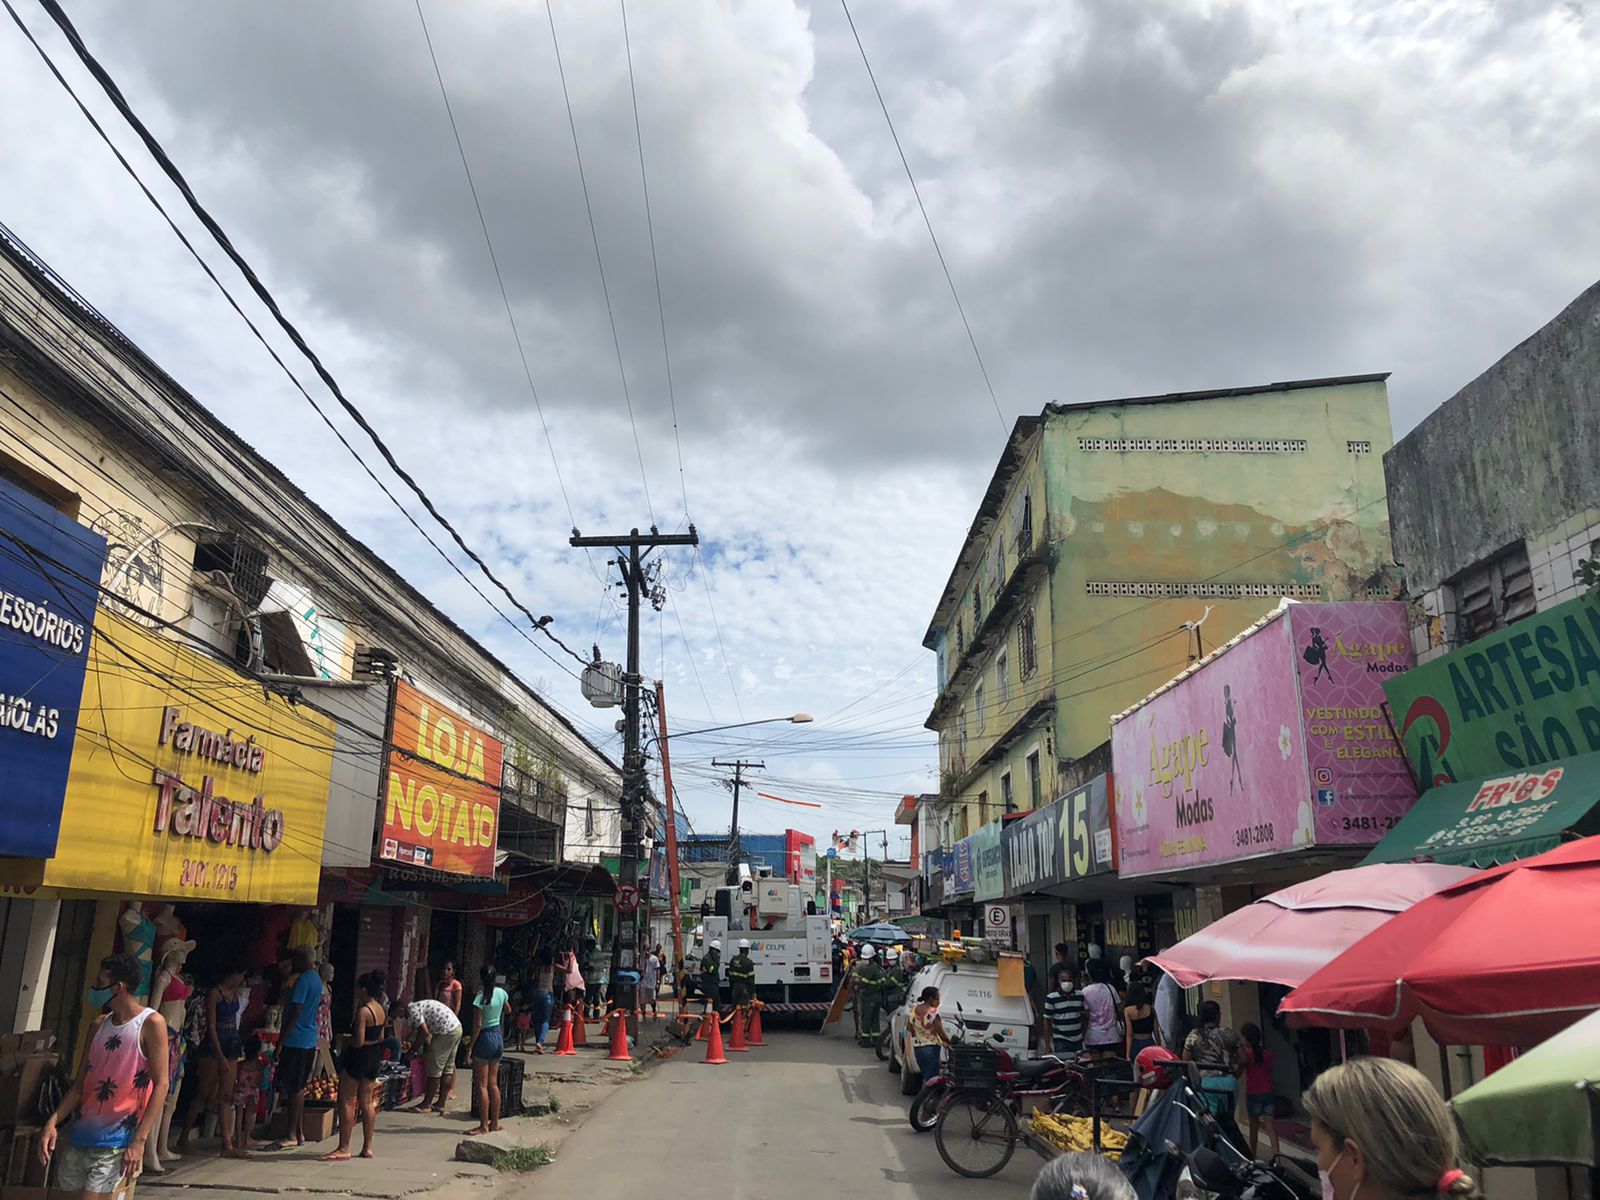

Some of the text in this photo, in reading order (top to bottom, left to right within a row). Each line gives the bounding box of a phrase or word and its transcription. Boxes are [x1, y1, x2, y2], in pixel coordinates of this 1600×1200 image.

[0, 591, 85, 654] ESSÓRIOS
[1332, 630, 1405, 662] Ágape
[1366, 662, 1409, 673] Modas
[1307, 707, 1381, 720] VESTINDO
[416, 705, 485, 780] LOJA
[1310, 725, 1339, 736] COM
[1148, 712, 1209, 799] Ágape
[1324, 739, 1332, 750] E
[153, 768, 284, 852] Talento
[1175, 790, 1214, 829] Modas
[1037, 817, 1055, 879] TOP
[1058, 791, 1089, 878] 15
[1235, 822, 1274, 848] 3481-2808
[993, 911, 1000, 922] E
[765, 943, 787, 951] CELPE
[979, 990, 992, 999] 116
